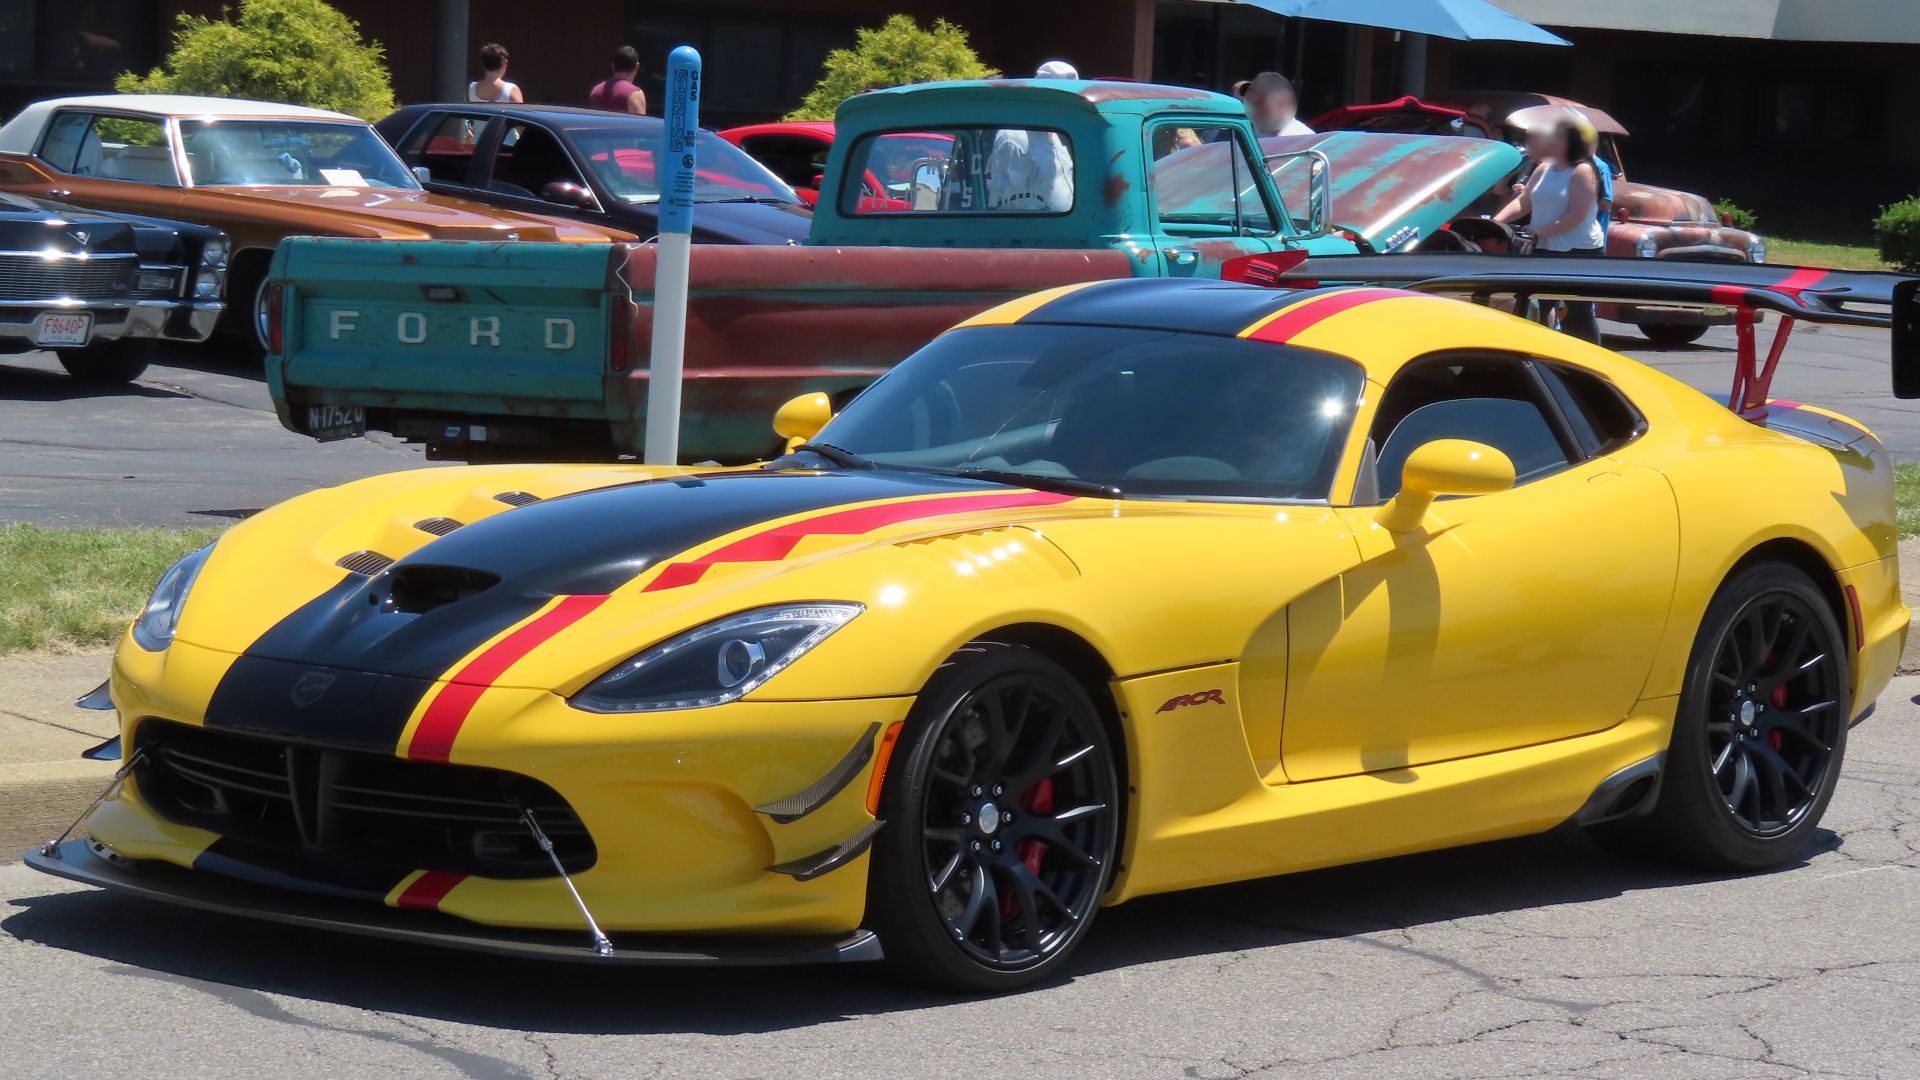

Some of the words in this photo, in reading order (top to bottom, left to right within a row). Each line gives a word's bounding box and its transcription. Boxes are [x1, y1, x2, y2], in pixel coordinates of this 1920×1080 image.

[690, 70, 699, 101] GAS
[672, 69, 688, 151] WARNING
[330, 310, 576, 350] FORD
[1154, 689, 1226, 714] ACR
